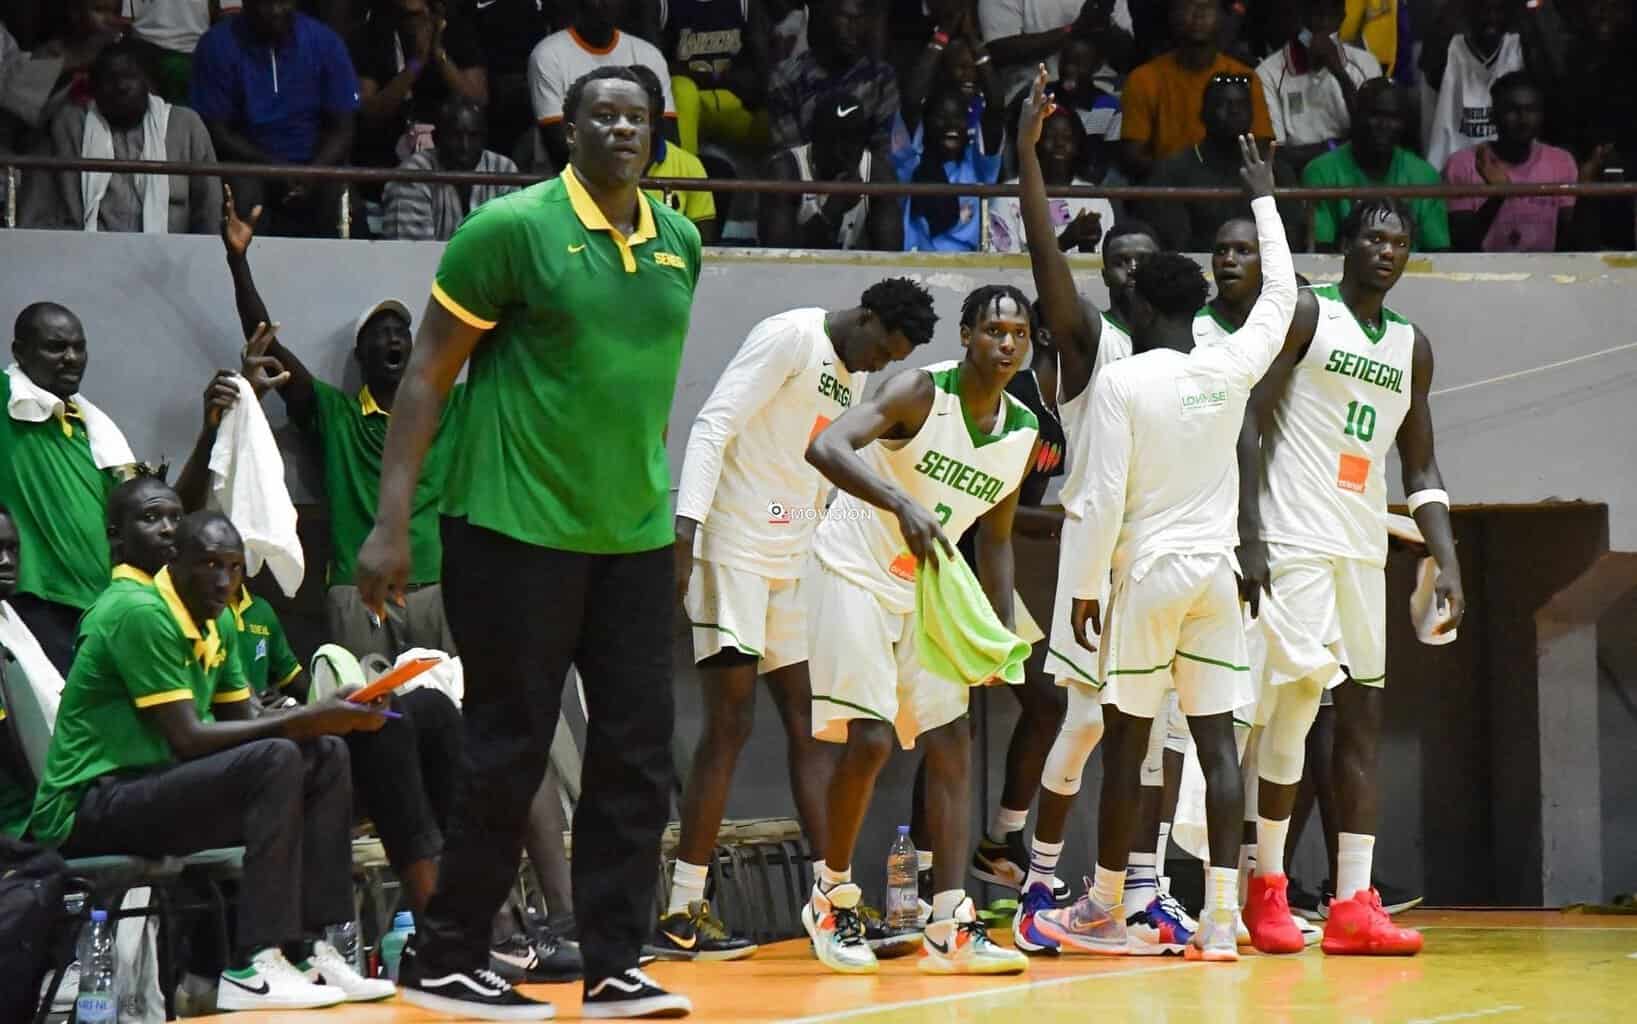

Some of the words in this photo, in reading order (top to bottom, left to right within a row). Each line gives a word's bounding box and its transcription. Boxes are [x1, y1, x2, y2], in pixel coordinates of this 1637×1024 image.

[818, 372, 851, 408] SENEG
[1324, 349, 1403, 394] SENEGAL
[1344, 400, 1377, 442] 10
[914, 450, 1005, 504] SENEGAL
